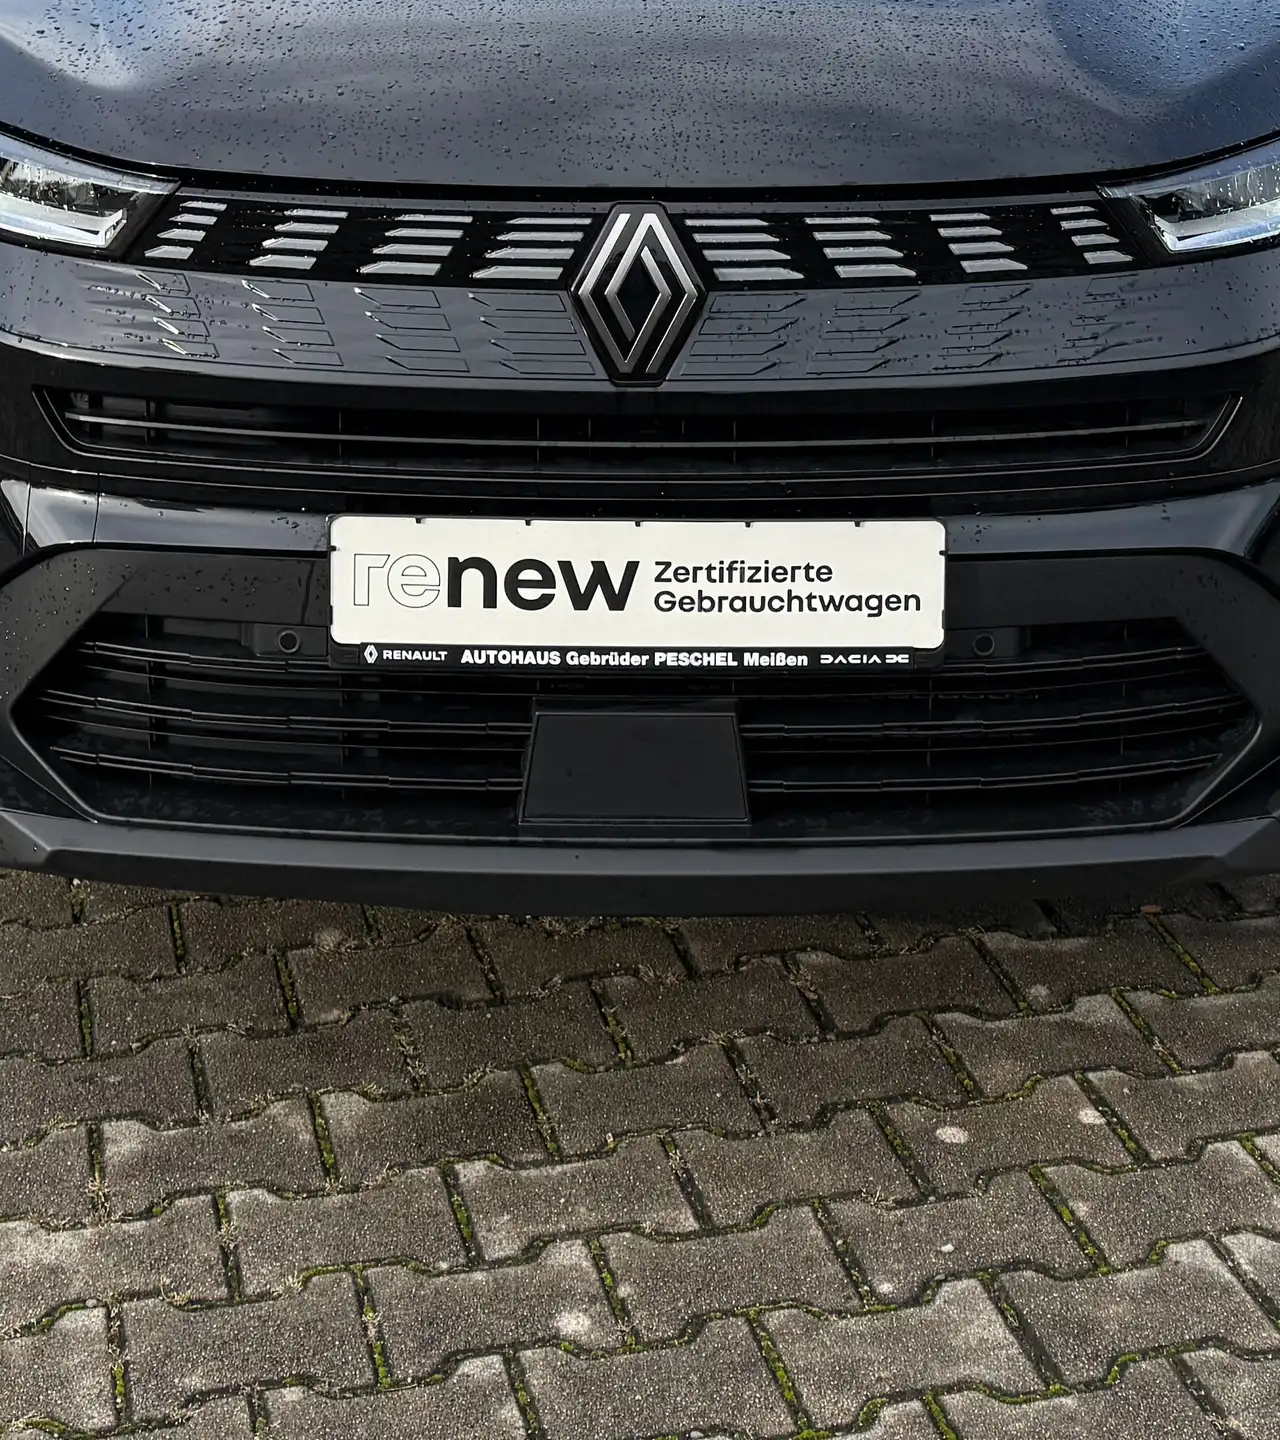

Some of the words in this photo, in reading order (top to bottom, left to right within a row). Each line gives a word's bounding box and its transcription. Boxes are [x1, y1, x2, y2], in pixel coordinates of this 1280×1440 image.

[353, 553, 641, 611] renew
[653, 560, 834, 584] Zertifizierte
[653, 588, 922, 618] Gebrauchtwagen
[382, 648, 448, 661] RENAULT
[460, 649, 562, 665] AUTOHAUS
[565, 650, 650, 666] Gebrüder
[654, 651, 739, 667] PESCHEL
[743, 651, 809, 667] Meißen
[819, 653, 882, 665] DACIA
